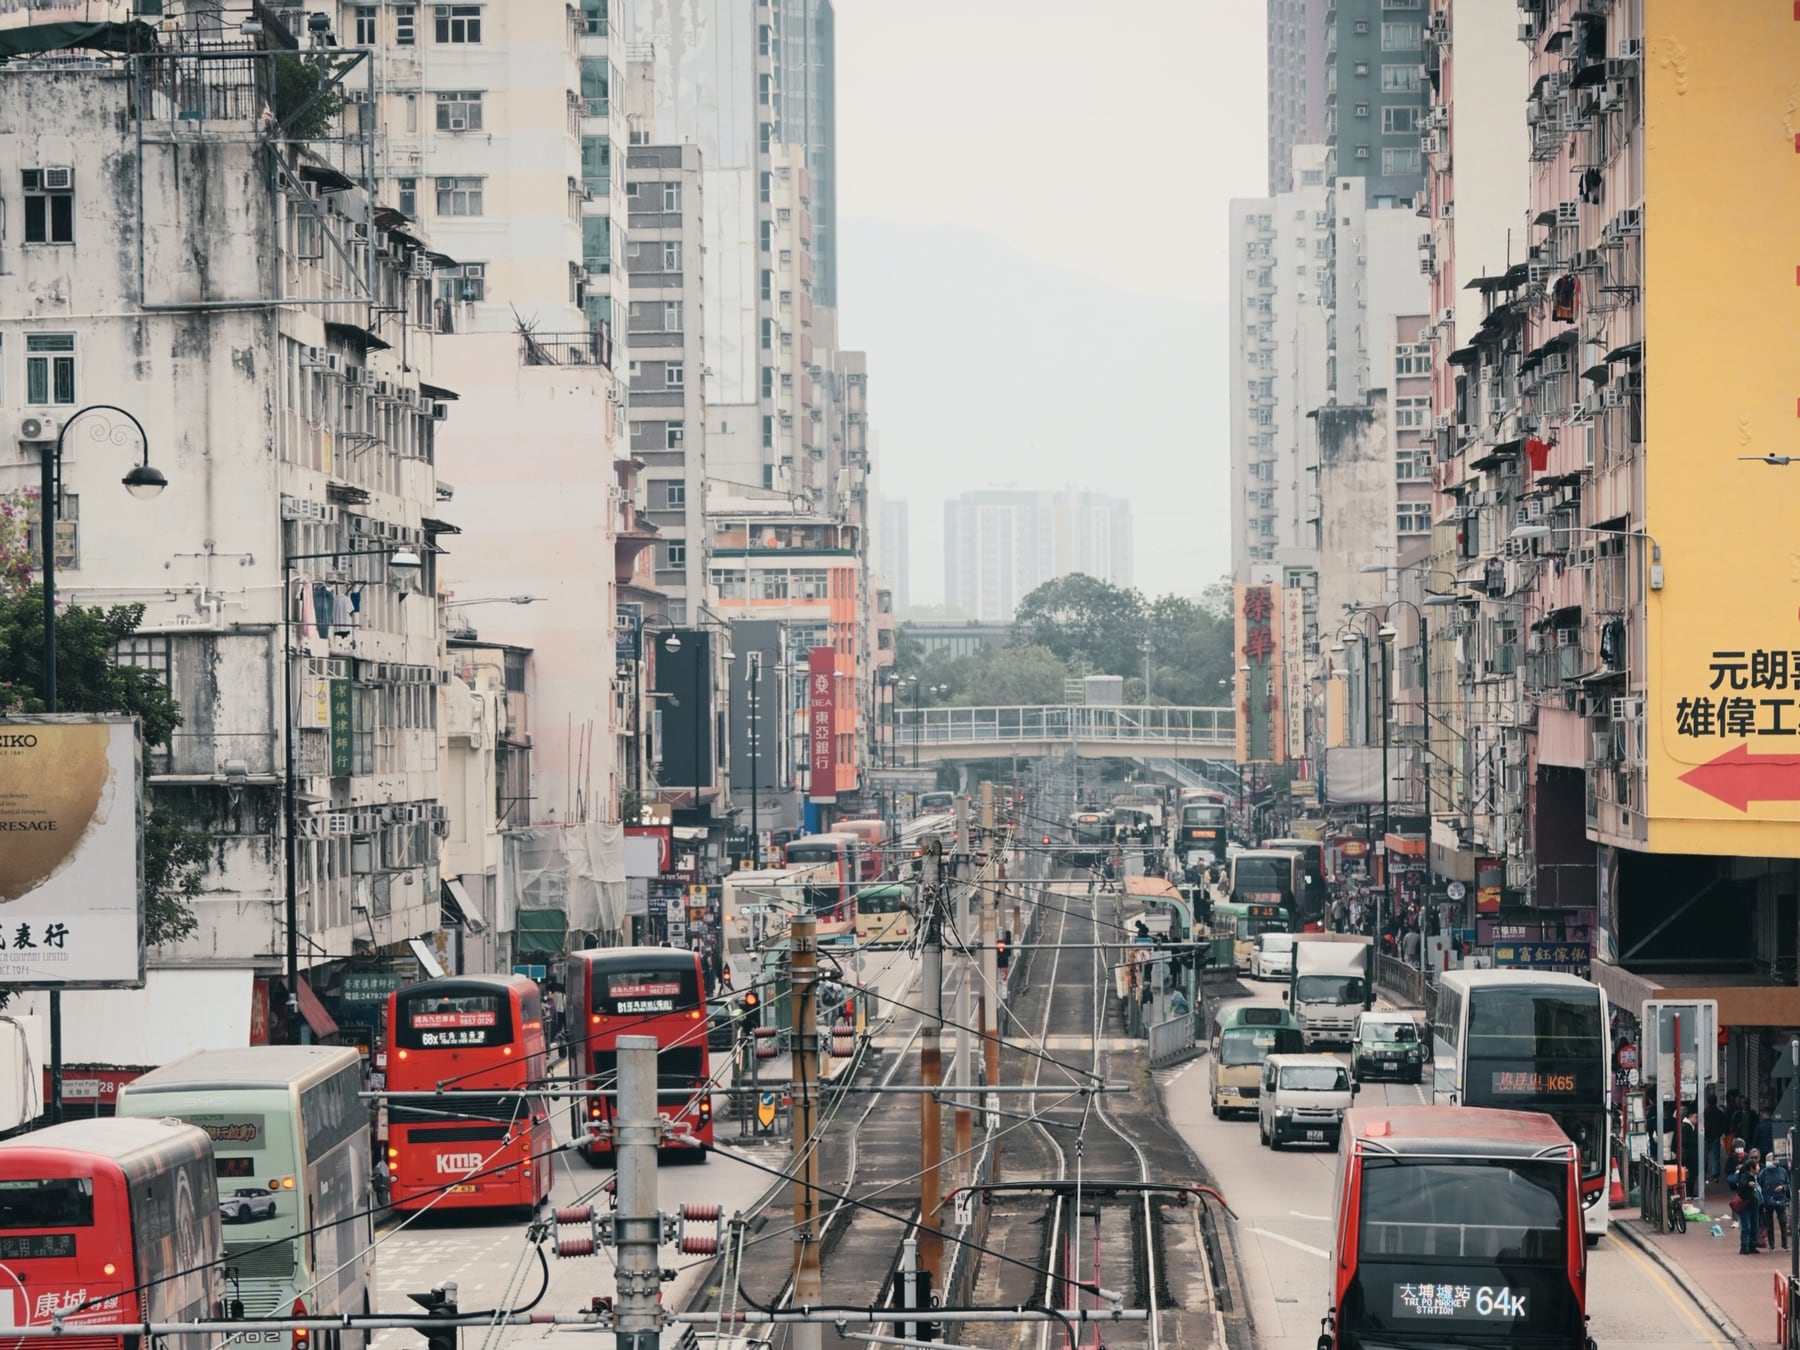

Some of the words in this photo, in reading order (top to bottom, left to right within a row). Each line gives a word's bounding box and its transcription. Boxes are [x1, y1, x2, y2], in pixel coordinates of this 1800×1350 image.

[1243, 587, 1275, 665] 榮華
[1709, 649, 1800, 691] 元朗
[1676, 696, 1800, 738] 雄偉工
[0, 734, 38, 748] IKO
[815, 711, 829, 769] 東亞銀行
[43, 952, 69, 961] LIMITED
[1549, 1075, 1574, 1091] K65
[436, 1153, 483, 1173] KMB
[1400, 1282, 1471, 1300] 大埔墟站
[1404, 1297, 1419, 1306] TAI
[1421, 1298, 1432, 1306] PO
[1435, 1298, 1468, 1308] MARKET
[1416, 1305, 1454, 1315] STATION
